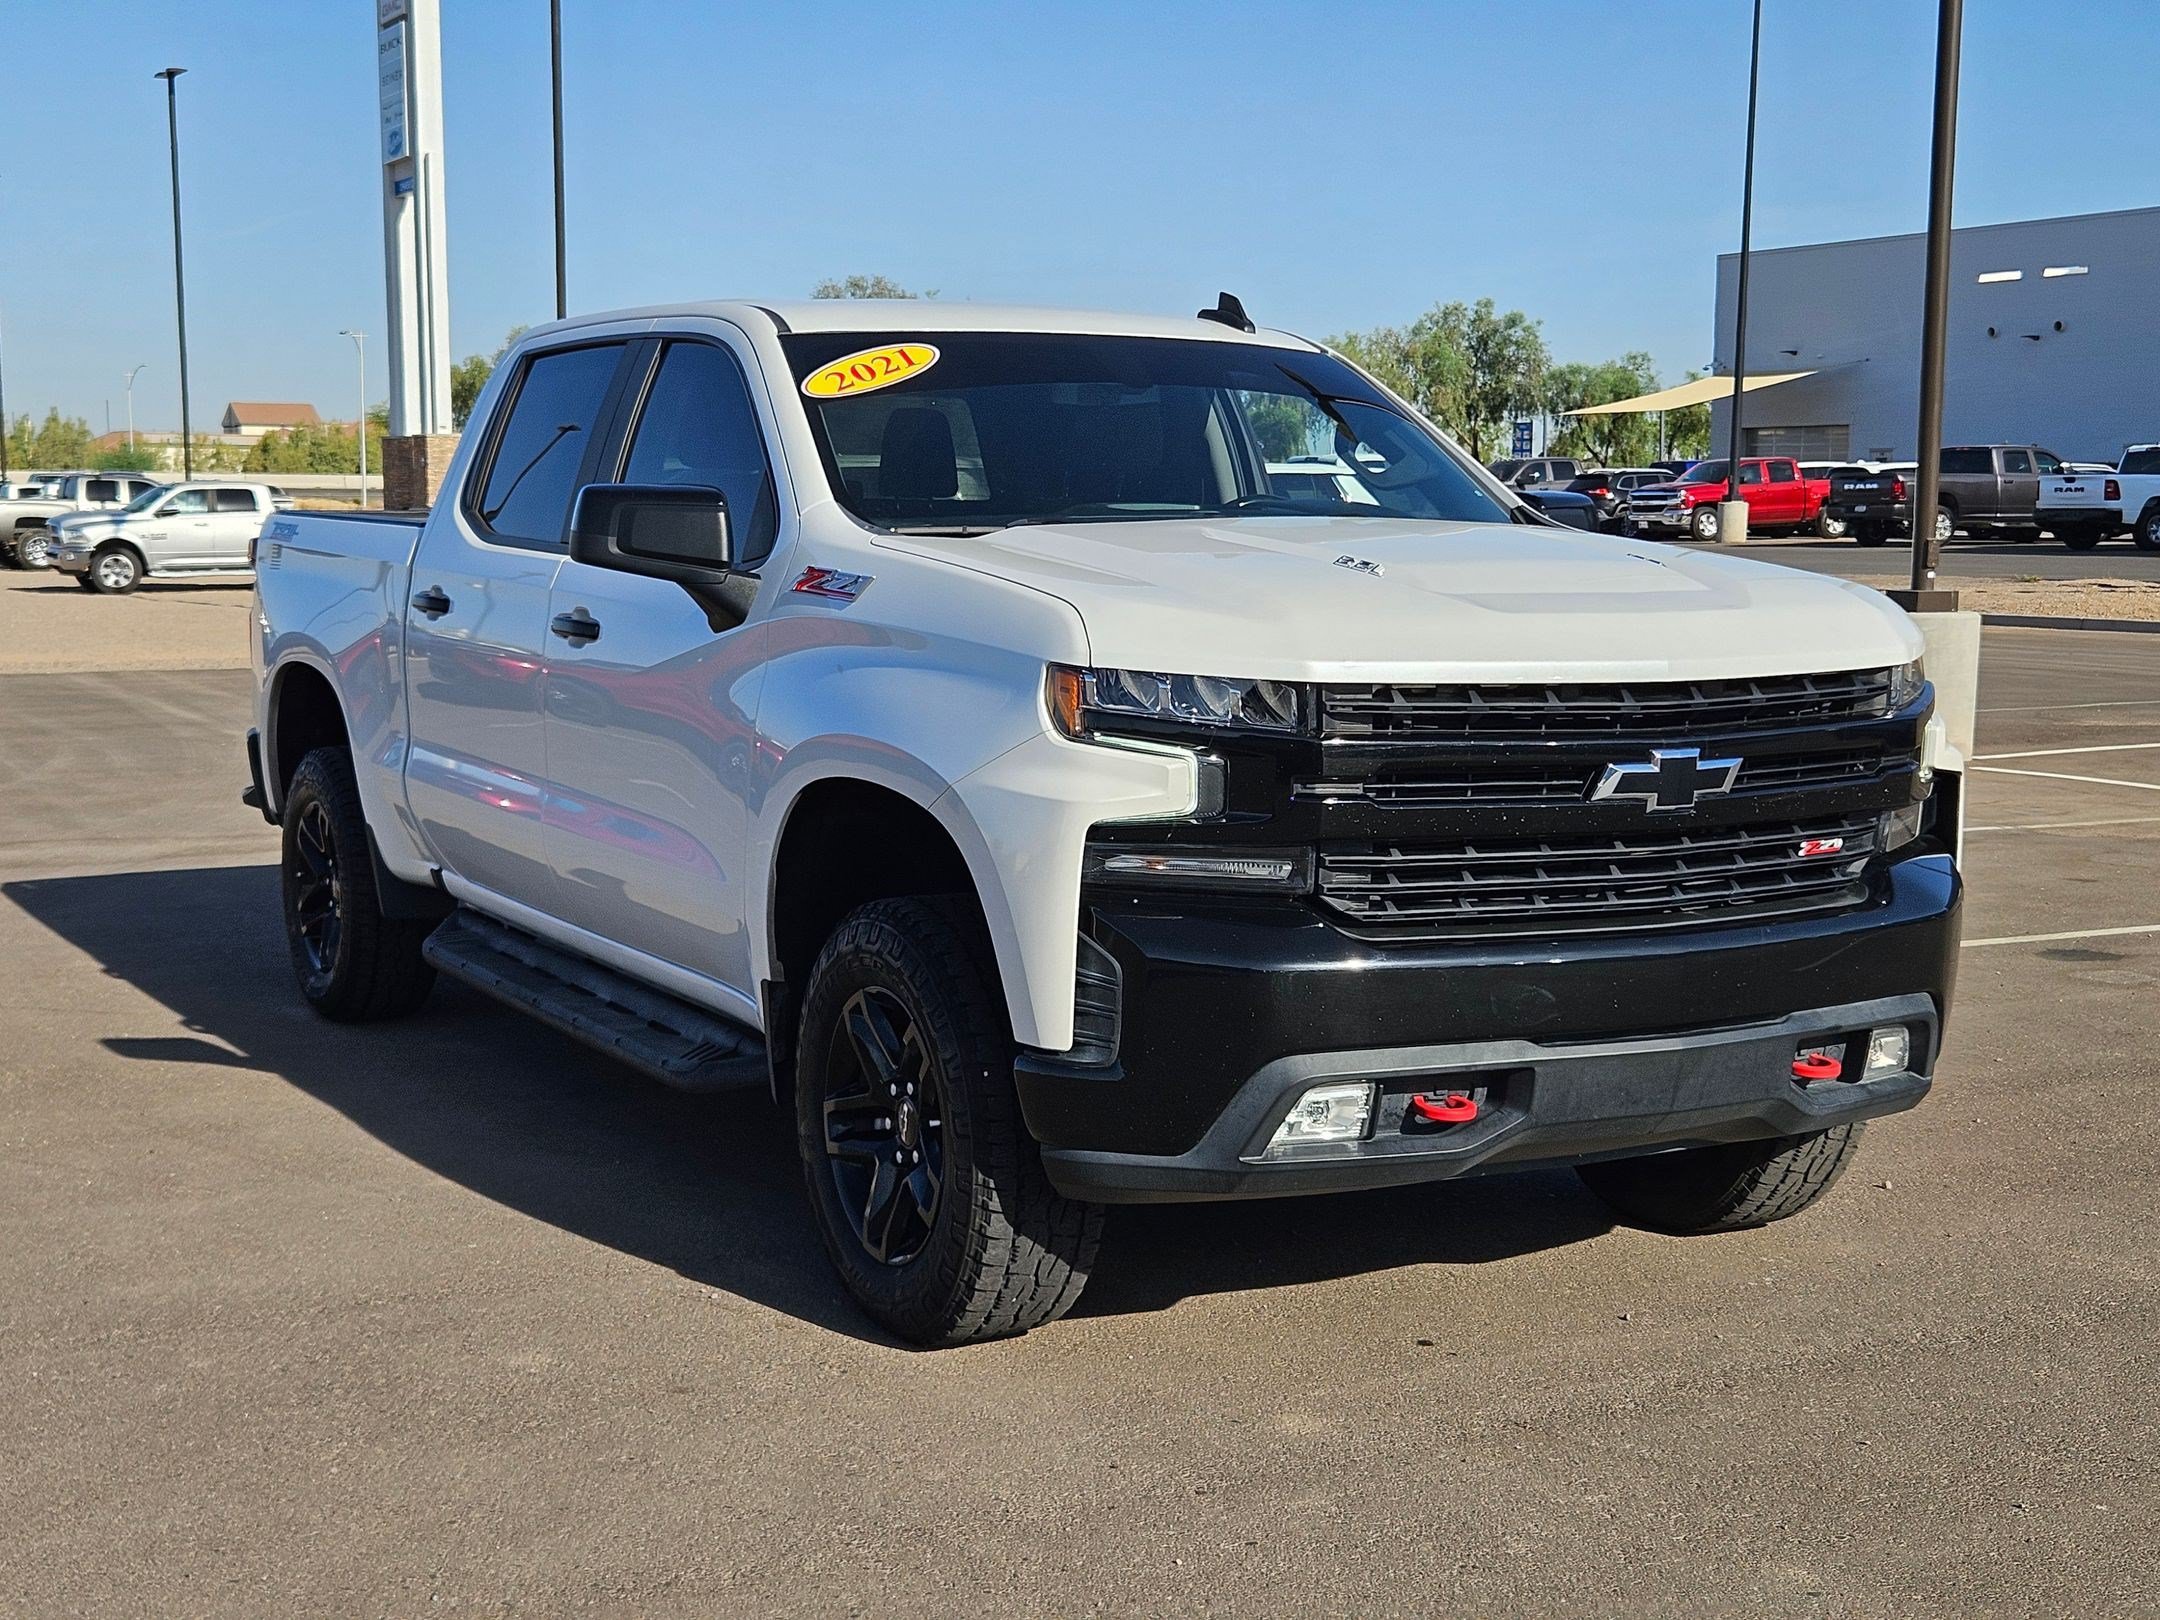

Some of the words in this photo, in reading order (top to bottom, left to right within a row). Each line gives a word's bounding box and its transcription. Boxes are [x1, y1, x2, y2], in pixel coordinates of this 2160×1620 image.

[824, 348, 921, 393] 2021
[792, 565, 876, 602] Z71
[1797, 837, 1844, 857] Z71
